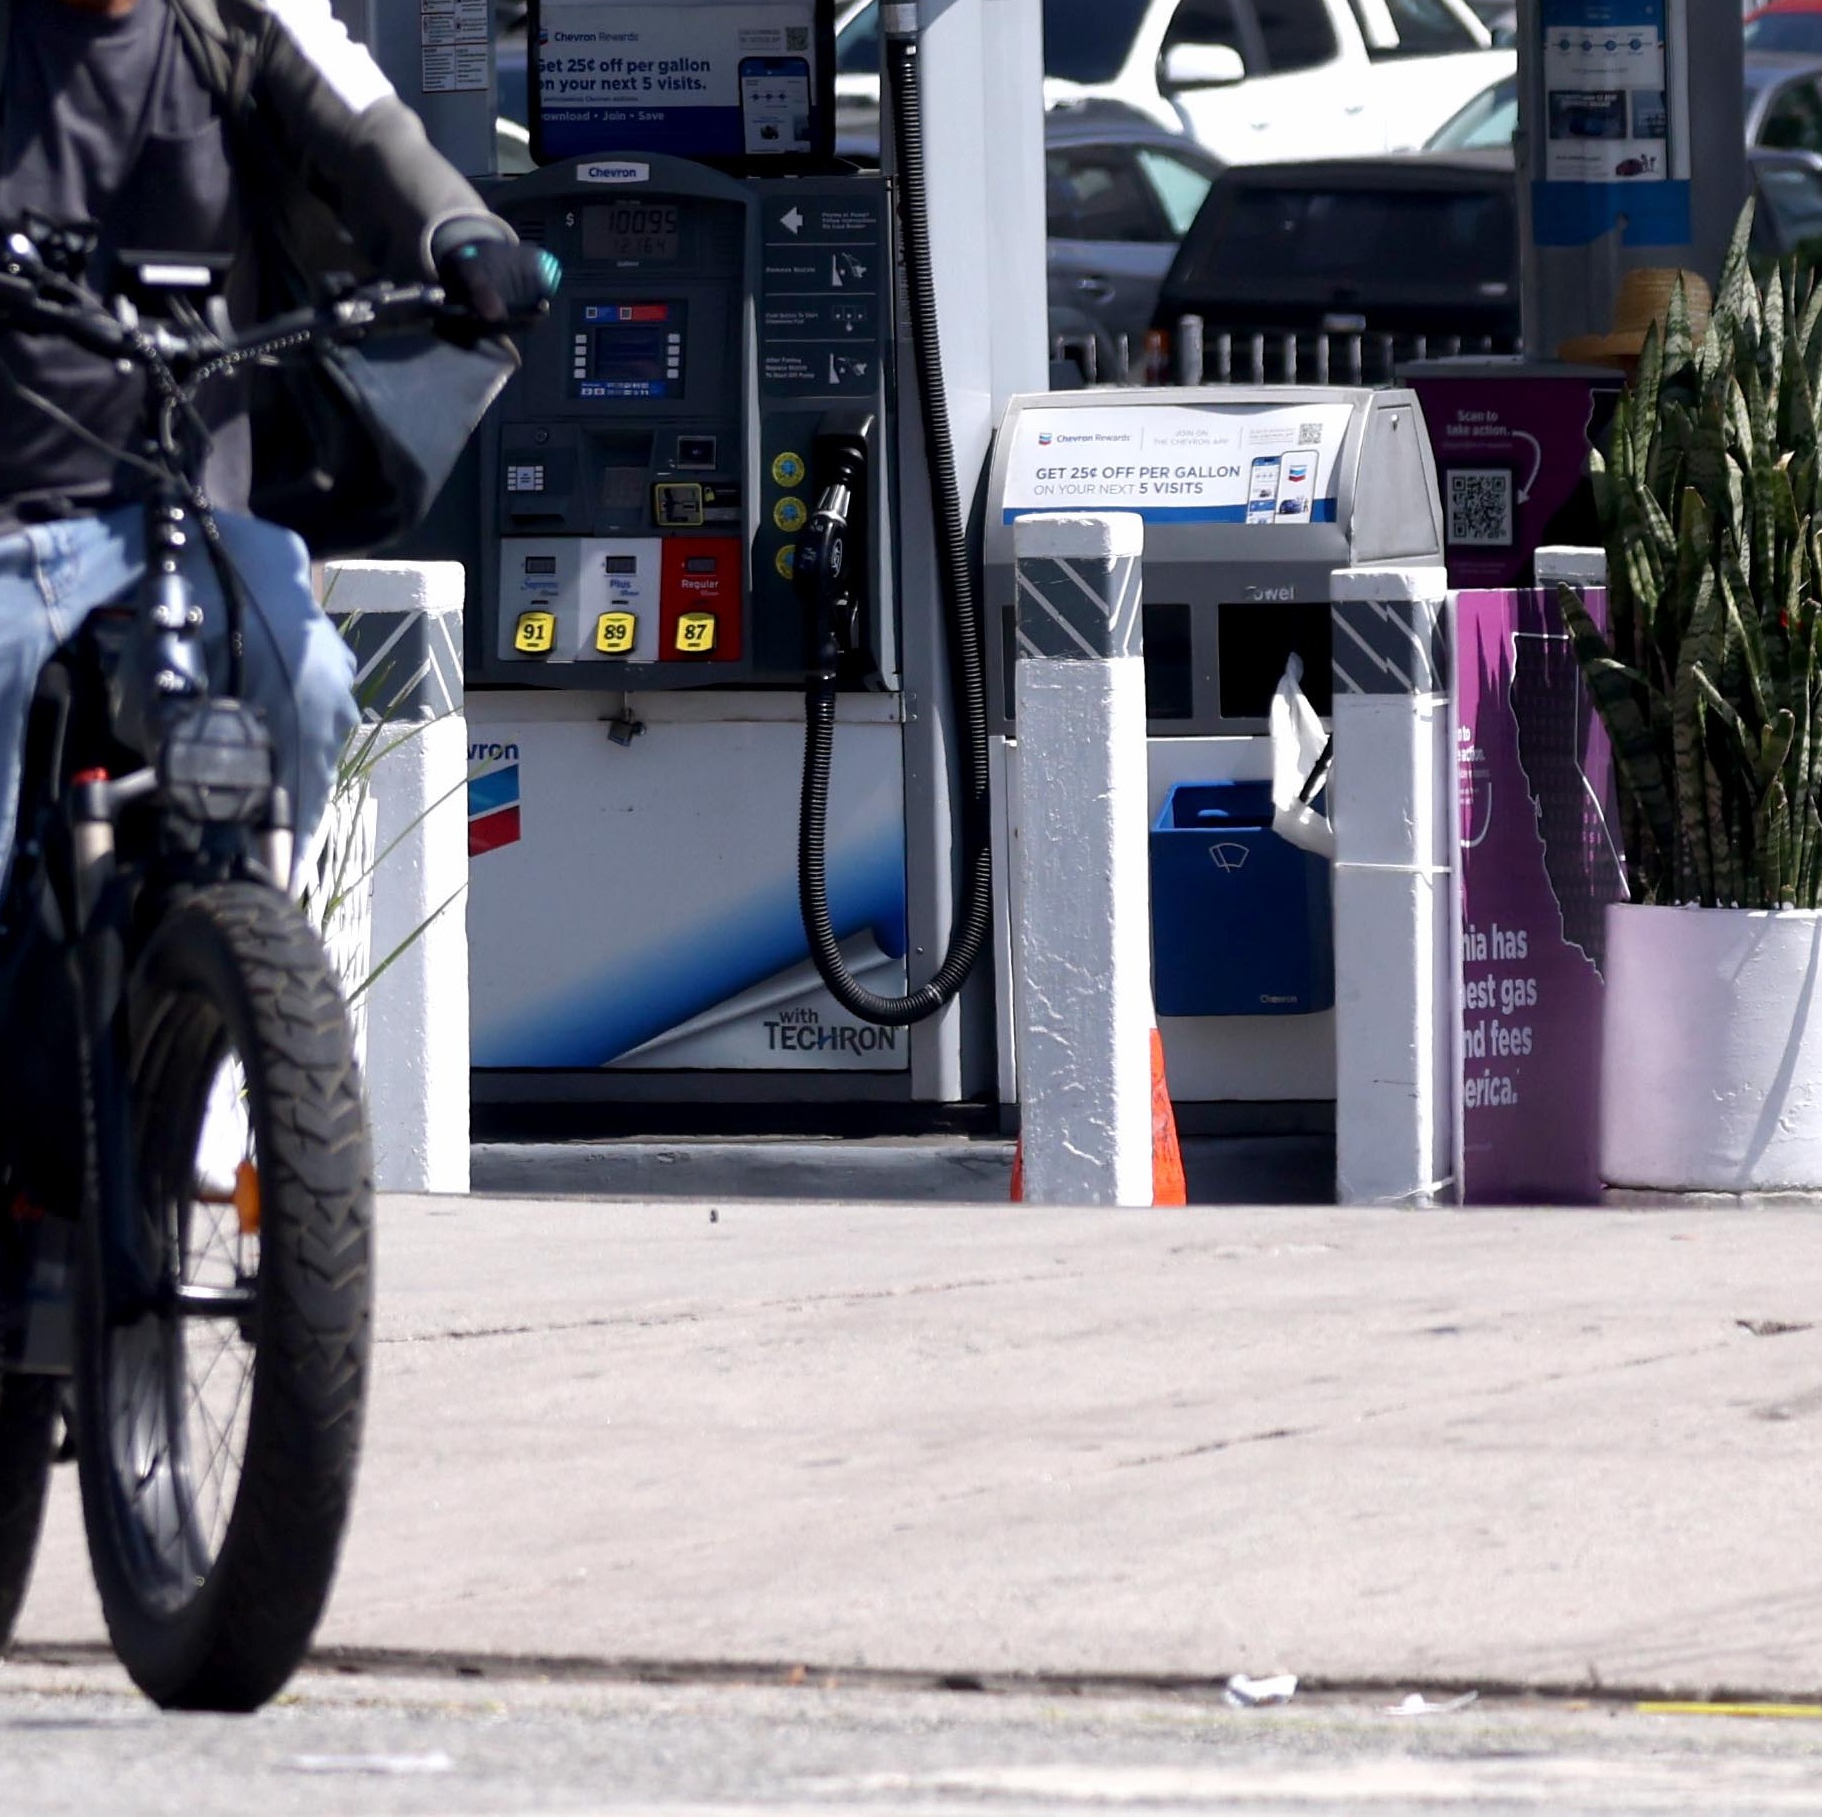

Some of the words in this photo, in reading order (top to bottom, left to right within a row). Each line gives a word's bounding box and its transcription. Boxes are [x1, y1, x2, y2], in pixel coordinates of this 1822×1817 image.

[554, 31, 596, 43] Chevron
[598, 31, 641, 43] Rewards
[567, 57, 595, 74] 25¢
[600, 58, 623, 73] off
[627, 60, 655, 76] per
[658, 58, 711, 76] gallon
[560, 78, 595, 94] your
[601, 77, 637, 91] next
[643, 76, 653, 91] 5
[657, 76, 708, 91] visits.
[541, 110, 591, 123] ownload
[601, 110, 628, 124] Join
[637, 110, 666, 122] Save
[588, 167, 637, 179] Chevron
[566, 212, 575, 228] $
[1457, 409, 1484, 422] Scan
[1486, 409, 1499, 422] to
[1057, 433, 1094, 444] Chevron
[1095, 433, 1132, 443] Rewards
[1447, 425, 1470, 437] take
[1036, 466, 1066, 480] GET
[1070, 466, 1098, 480] 25¢
[1102, 466, 1135, 479] OFF
[1139, 466, 1170, 479] PER
[1175, 465, 1241, 479] GALLON
[1034, 484, 1055, 495] ON
[1058, 484, 1096, 495] YOUR
[1099, 483, 1135, 494] NEXT
[1139, 482, 1148, 494] 5
[1154, 482, 1203, 494] VISITS
[681, 579, 720, 590] Regular
[523, 624, 545, 641] 91
[604, 624, 627, 641] 89
[684, 624, 708, 641] 87
[1492, 923, 1528, 961] has
[1501, 977, 1538, 1015] gas
[779, 1006, 820, 1024] with
[763, 1021, 895, 1057] TECHRON
[1491, 1019, 1533, 1057] fees
